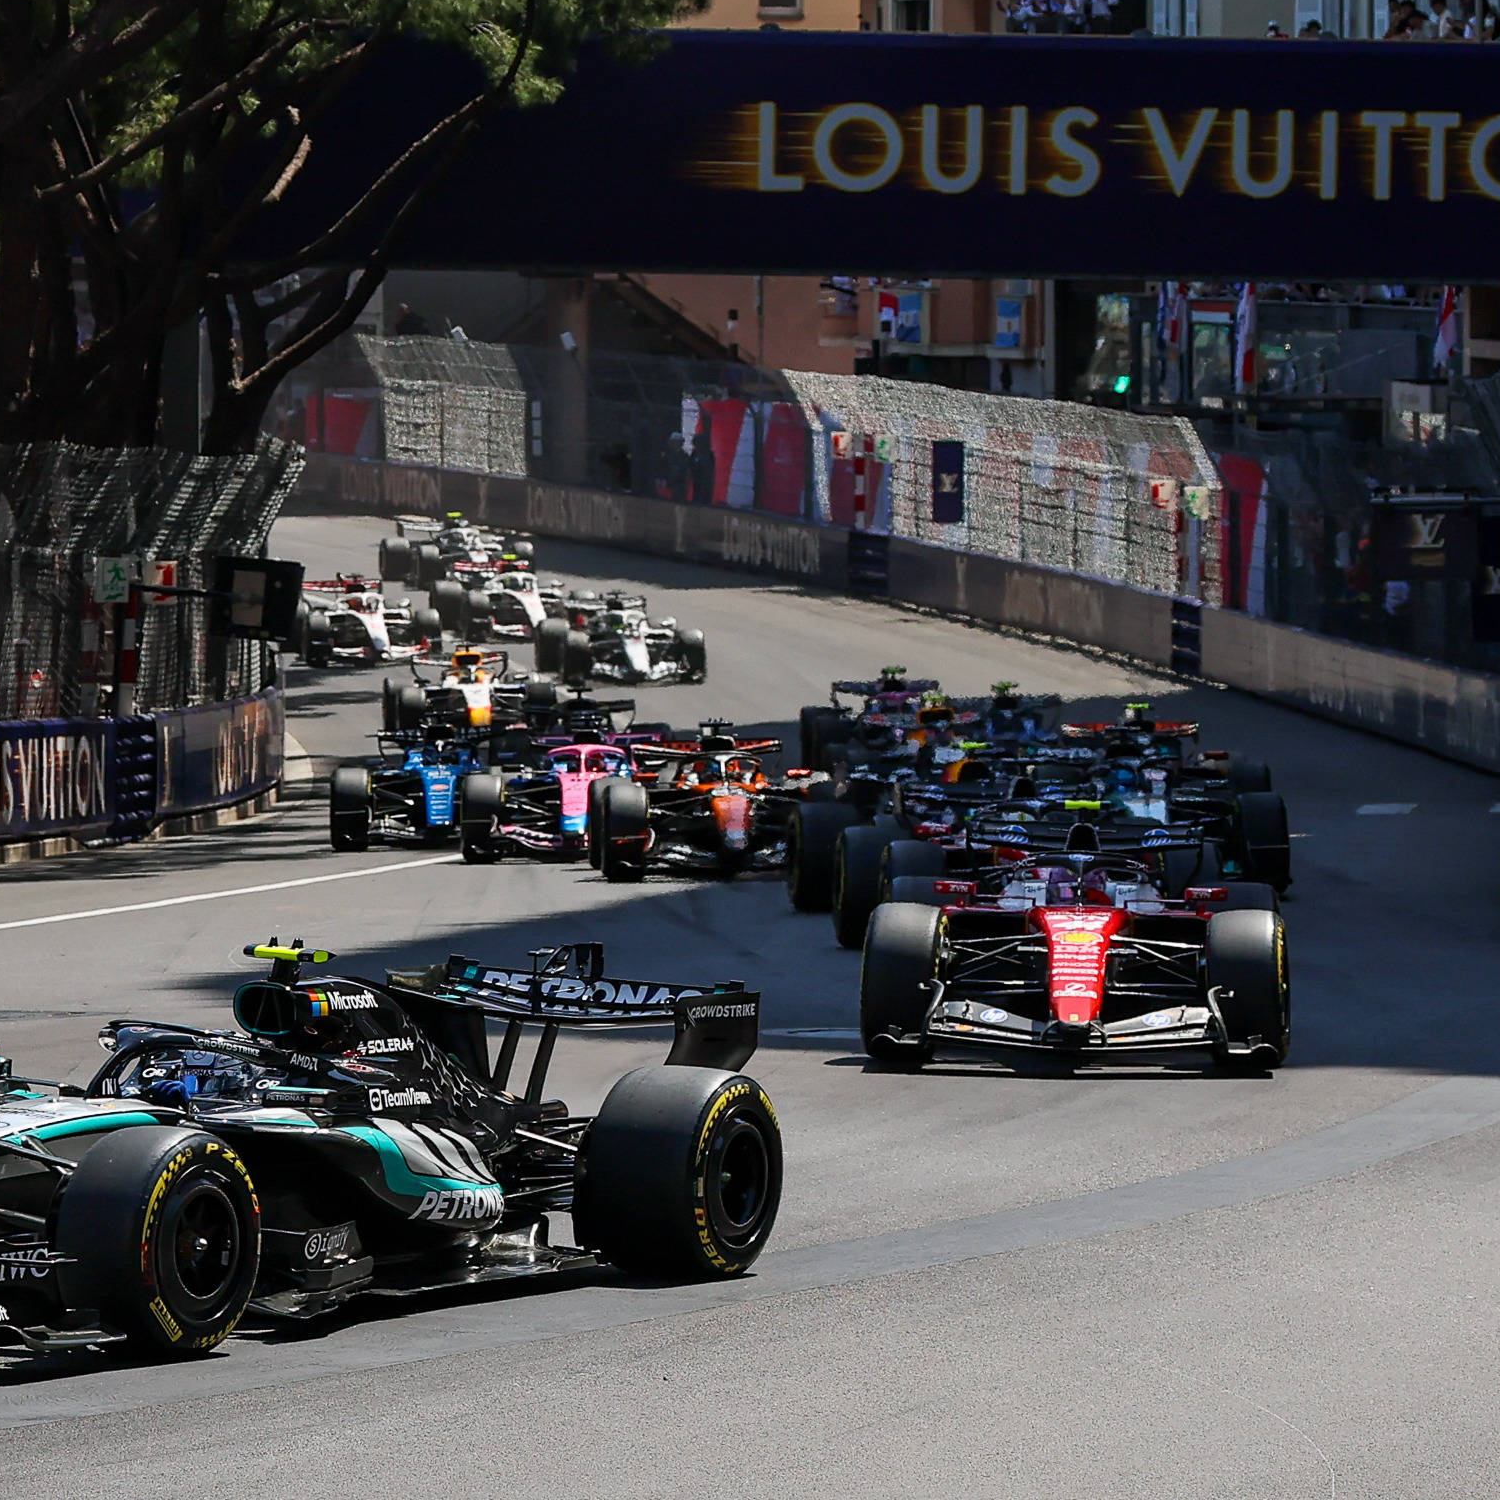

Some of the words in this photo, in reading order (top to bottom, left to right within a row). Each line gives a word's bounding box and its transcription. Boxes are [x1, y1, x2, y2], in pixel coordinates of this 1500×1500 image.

[759, 100, 1099, 197] LOUIS
[1409, 514, 1446, 548] LV
[17, 733, 106, 822] VUITTON
[327, 989, 378, 1011] Microsoft
[691, 1002, 756, 1019] CROWDSTRIKE
[199, 1038, 260, 1057] CROWDSTRIKE
[366, 1038, 408, 1055] SOLERA
[290, 1053, 311, 1068] AMD
[266, 1094, 305, 1103] PETRONAS
[206, 1143, 219, 1155] P
[408, 1187, 505, 1220] PETRONA
